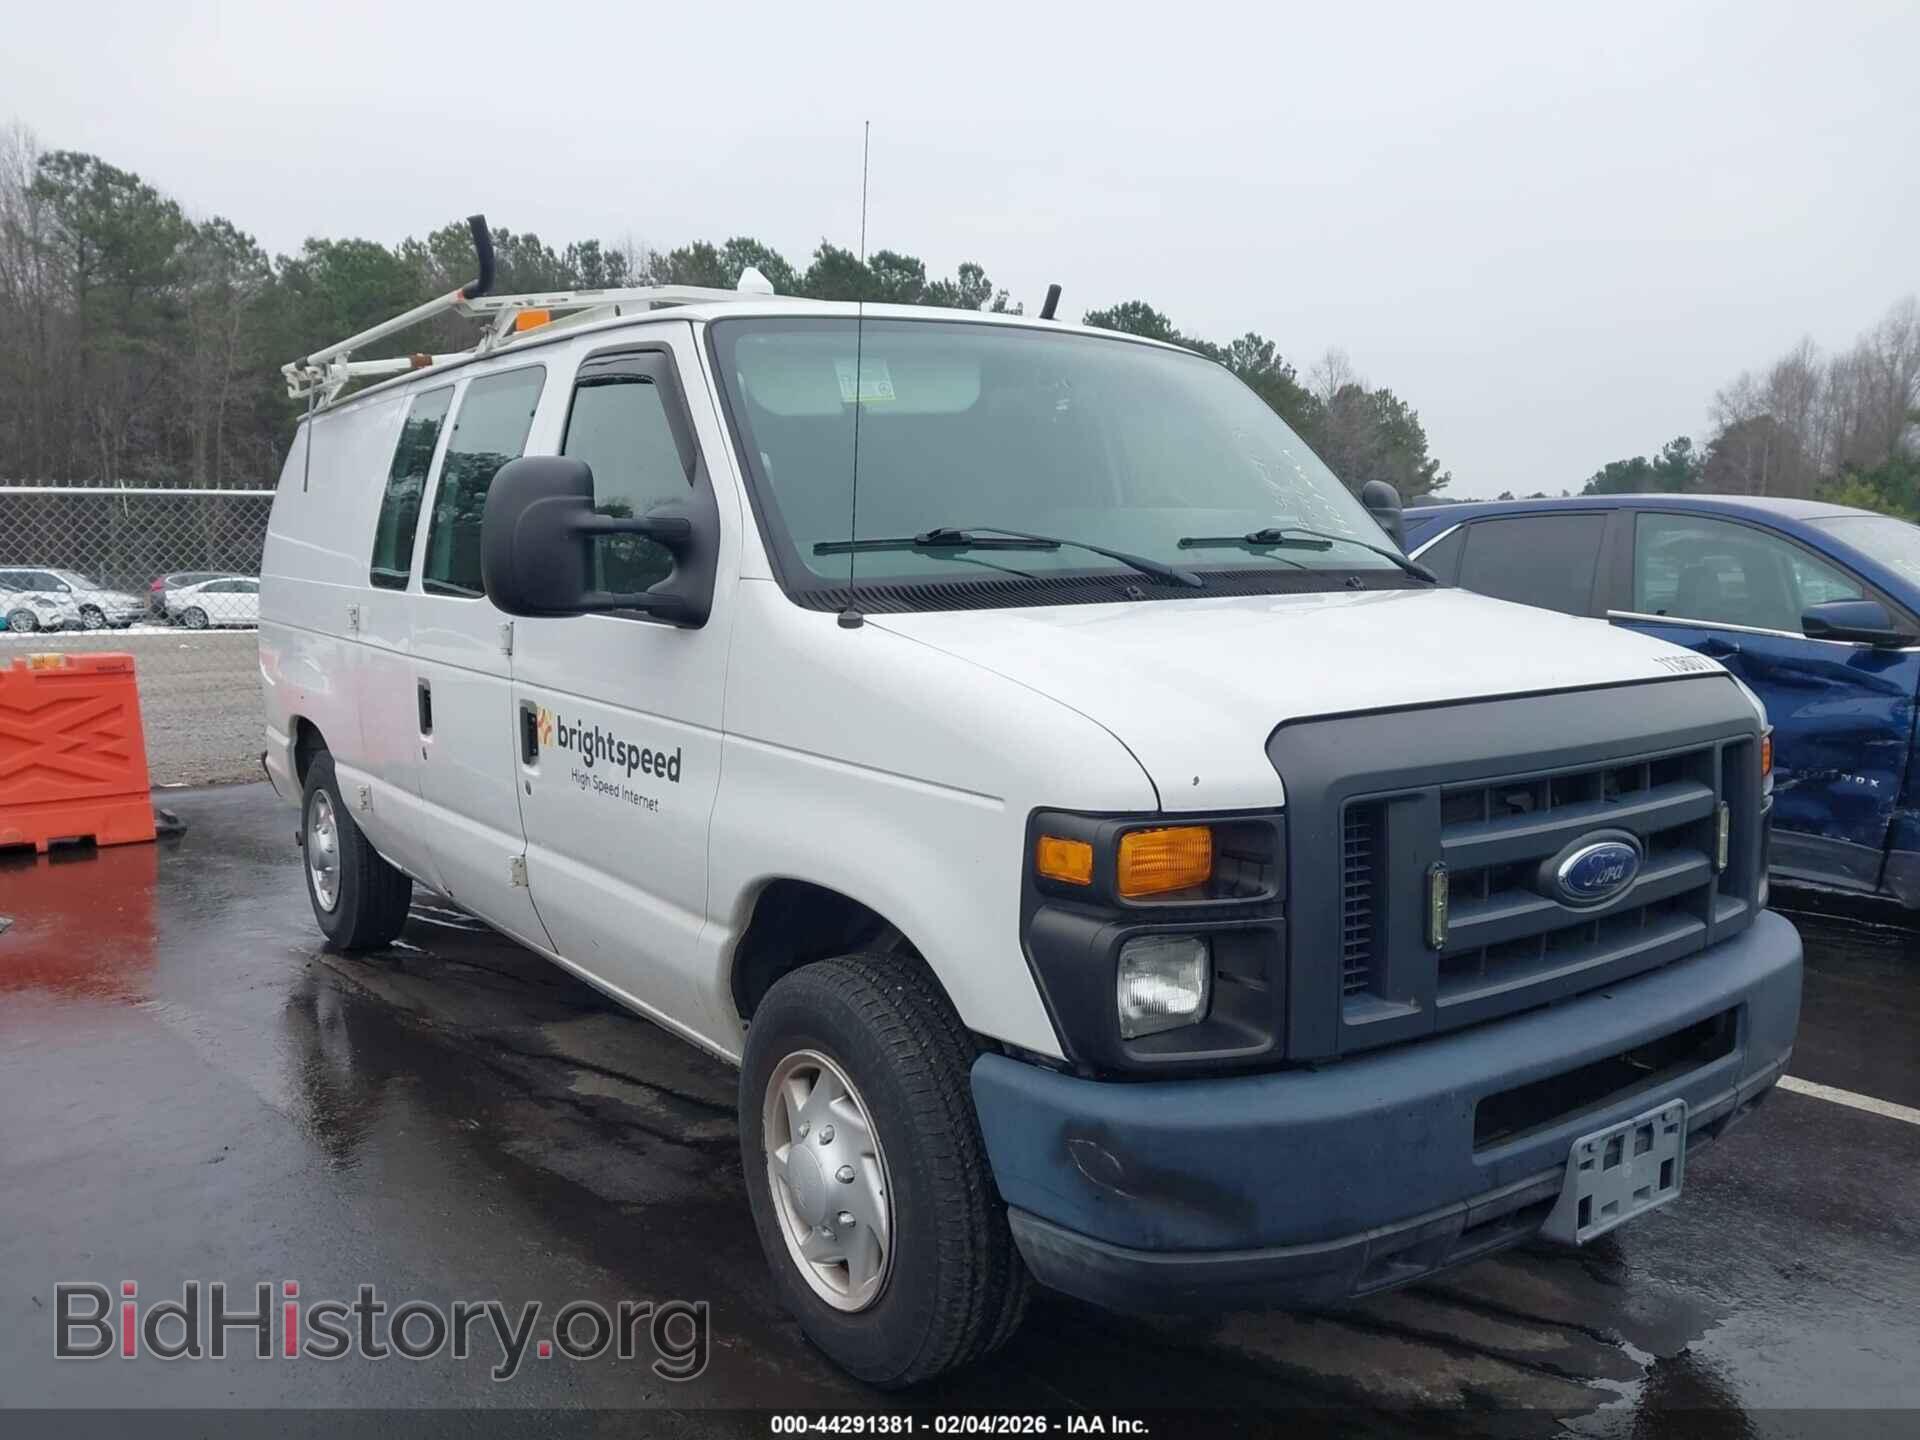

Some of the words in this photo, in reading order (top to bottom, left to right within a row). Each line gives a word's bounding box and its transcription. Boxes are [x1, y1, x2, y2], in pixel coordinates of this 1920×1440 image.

[557, 715, 682, 783] brightspeed
[571, 767, 591, 791] High
[592, 775, 620, 798] Speed
[621, 784, 660, 813] Internet
[1583, 852, 1625, 887] Ford
